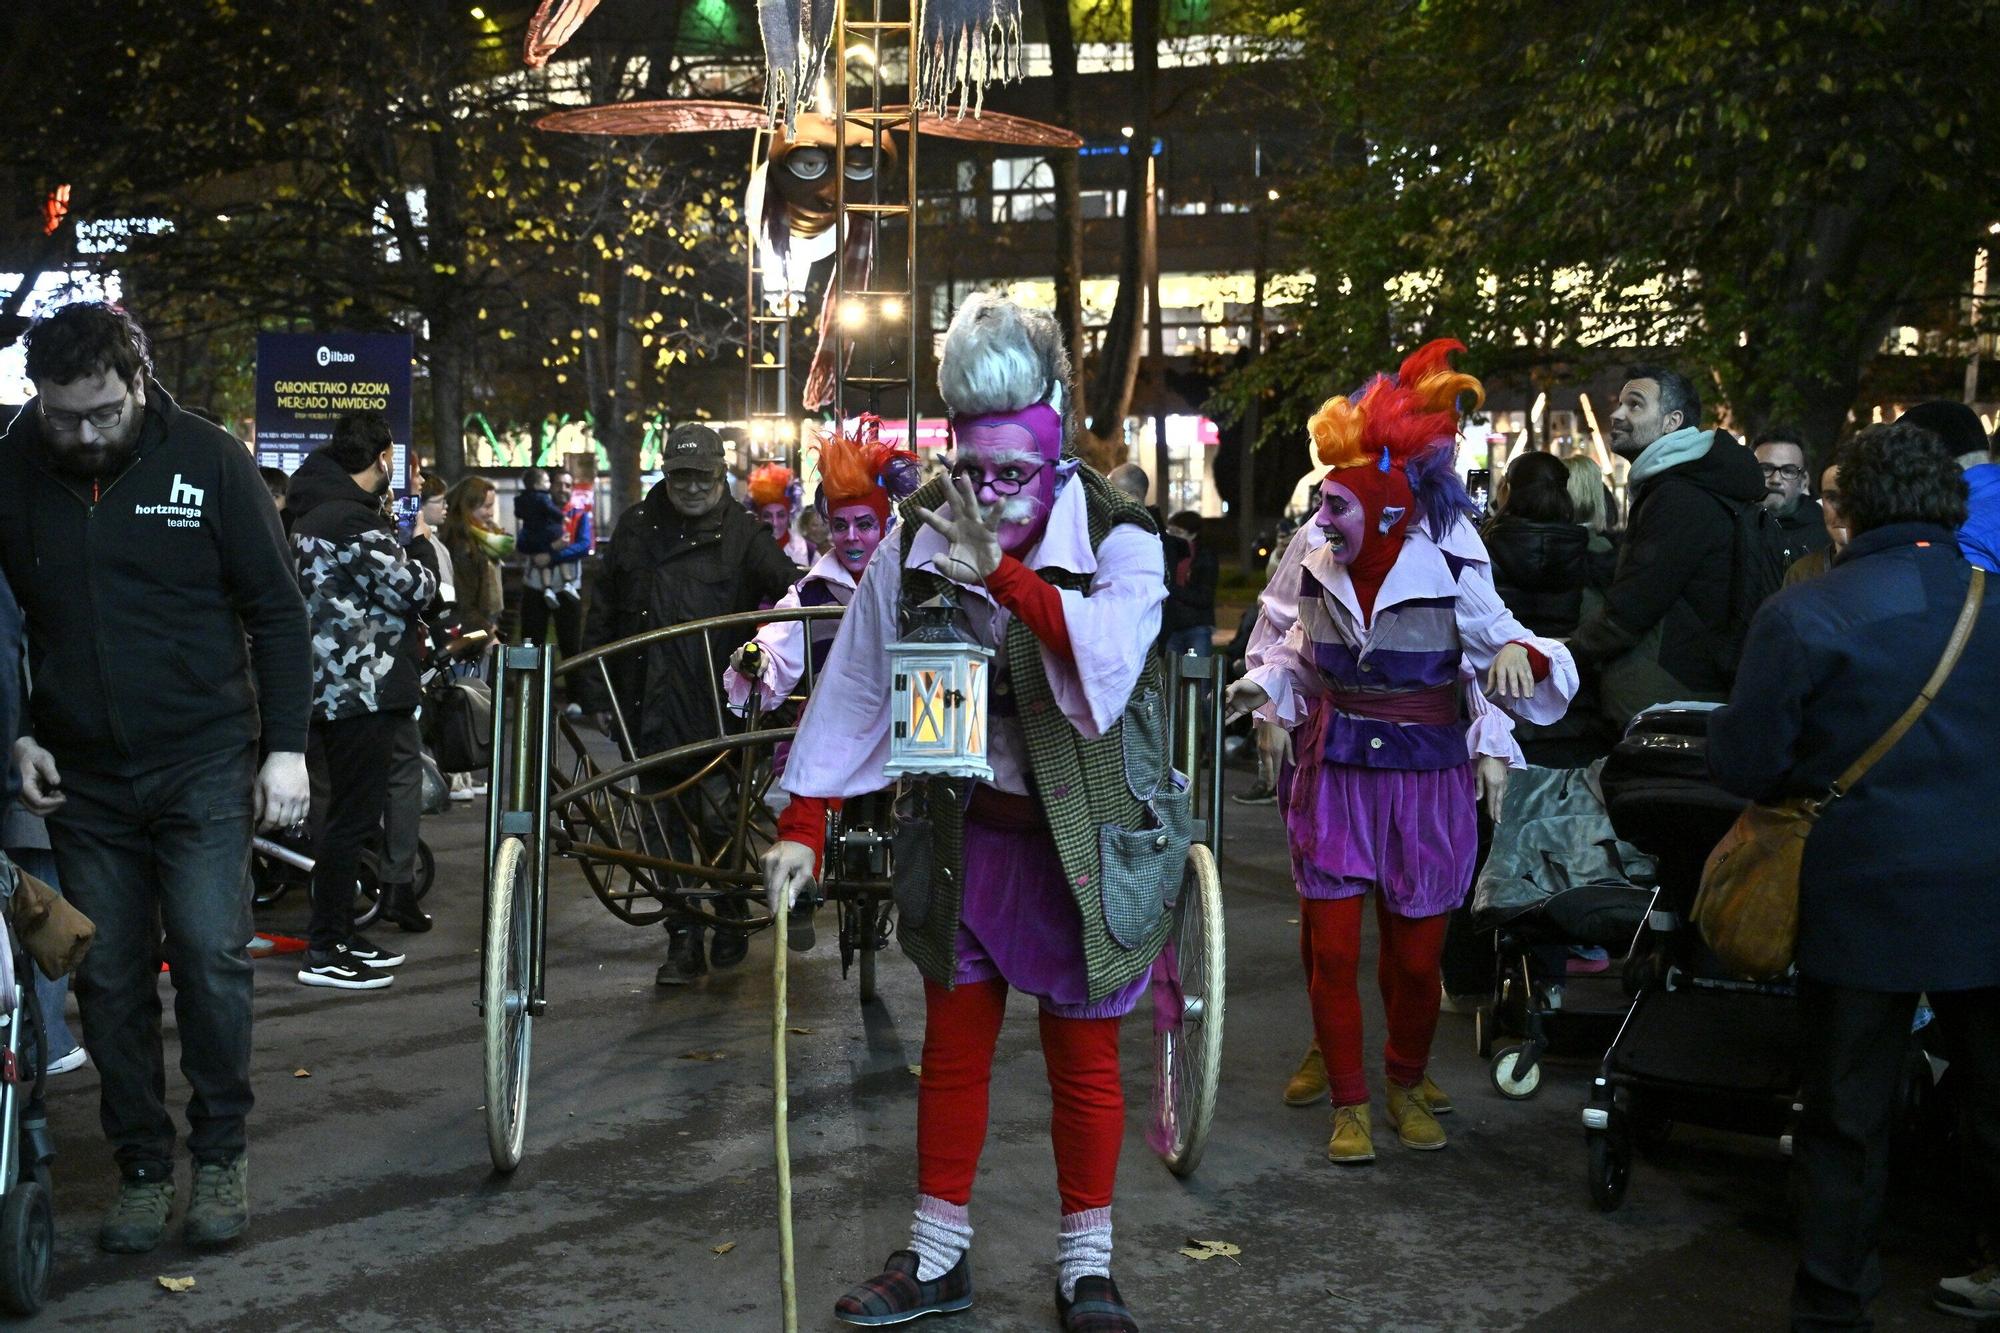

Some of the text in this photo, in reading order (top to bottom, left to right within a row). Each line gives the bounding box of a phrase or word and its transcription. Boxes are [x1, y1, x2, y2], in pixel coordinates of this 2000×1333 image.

[317, 346, 355, 366] Bilbao
[274, 381, 390, 395] GABONETAKO AZOKA
[277, 396, 386, 410] MERCADO NAVIDEÑO
[135, 504, 202, 518] hortzmuga
[167, 518, 200, 527] teatroa
